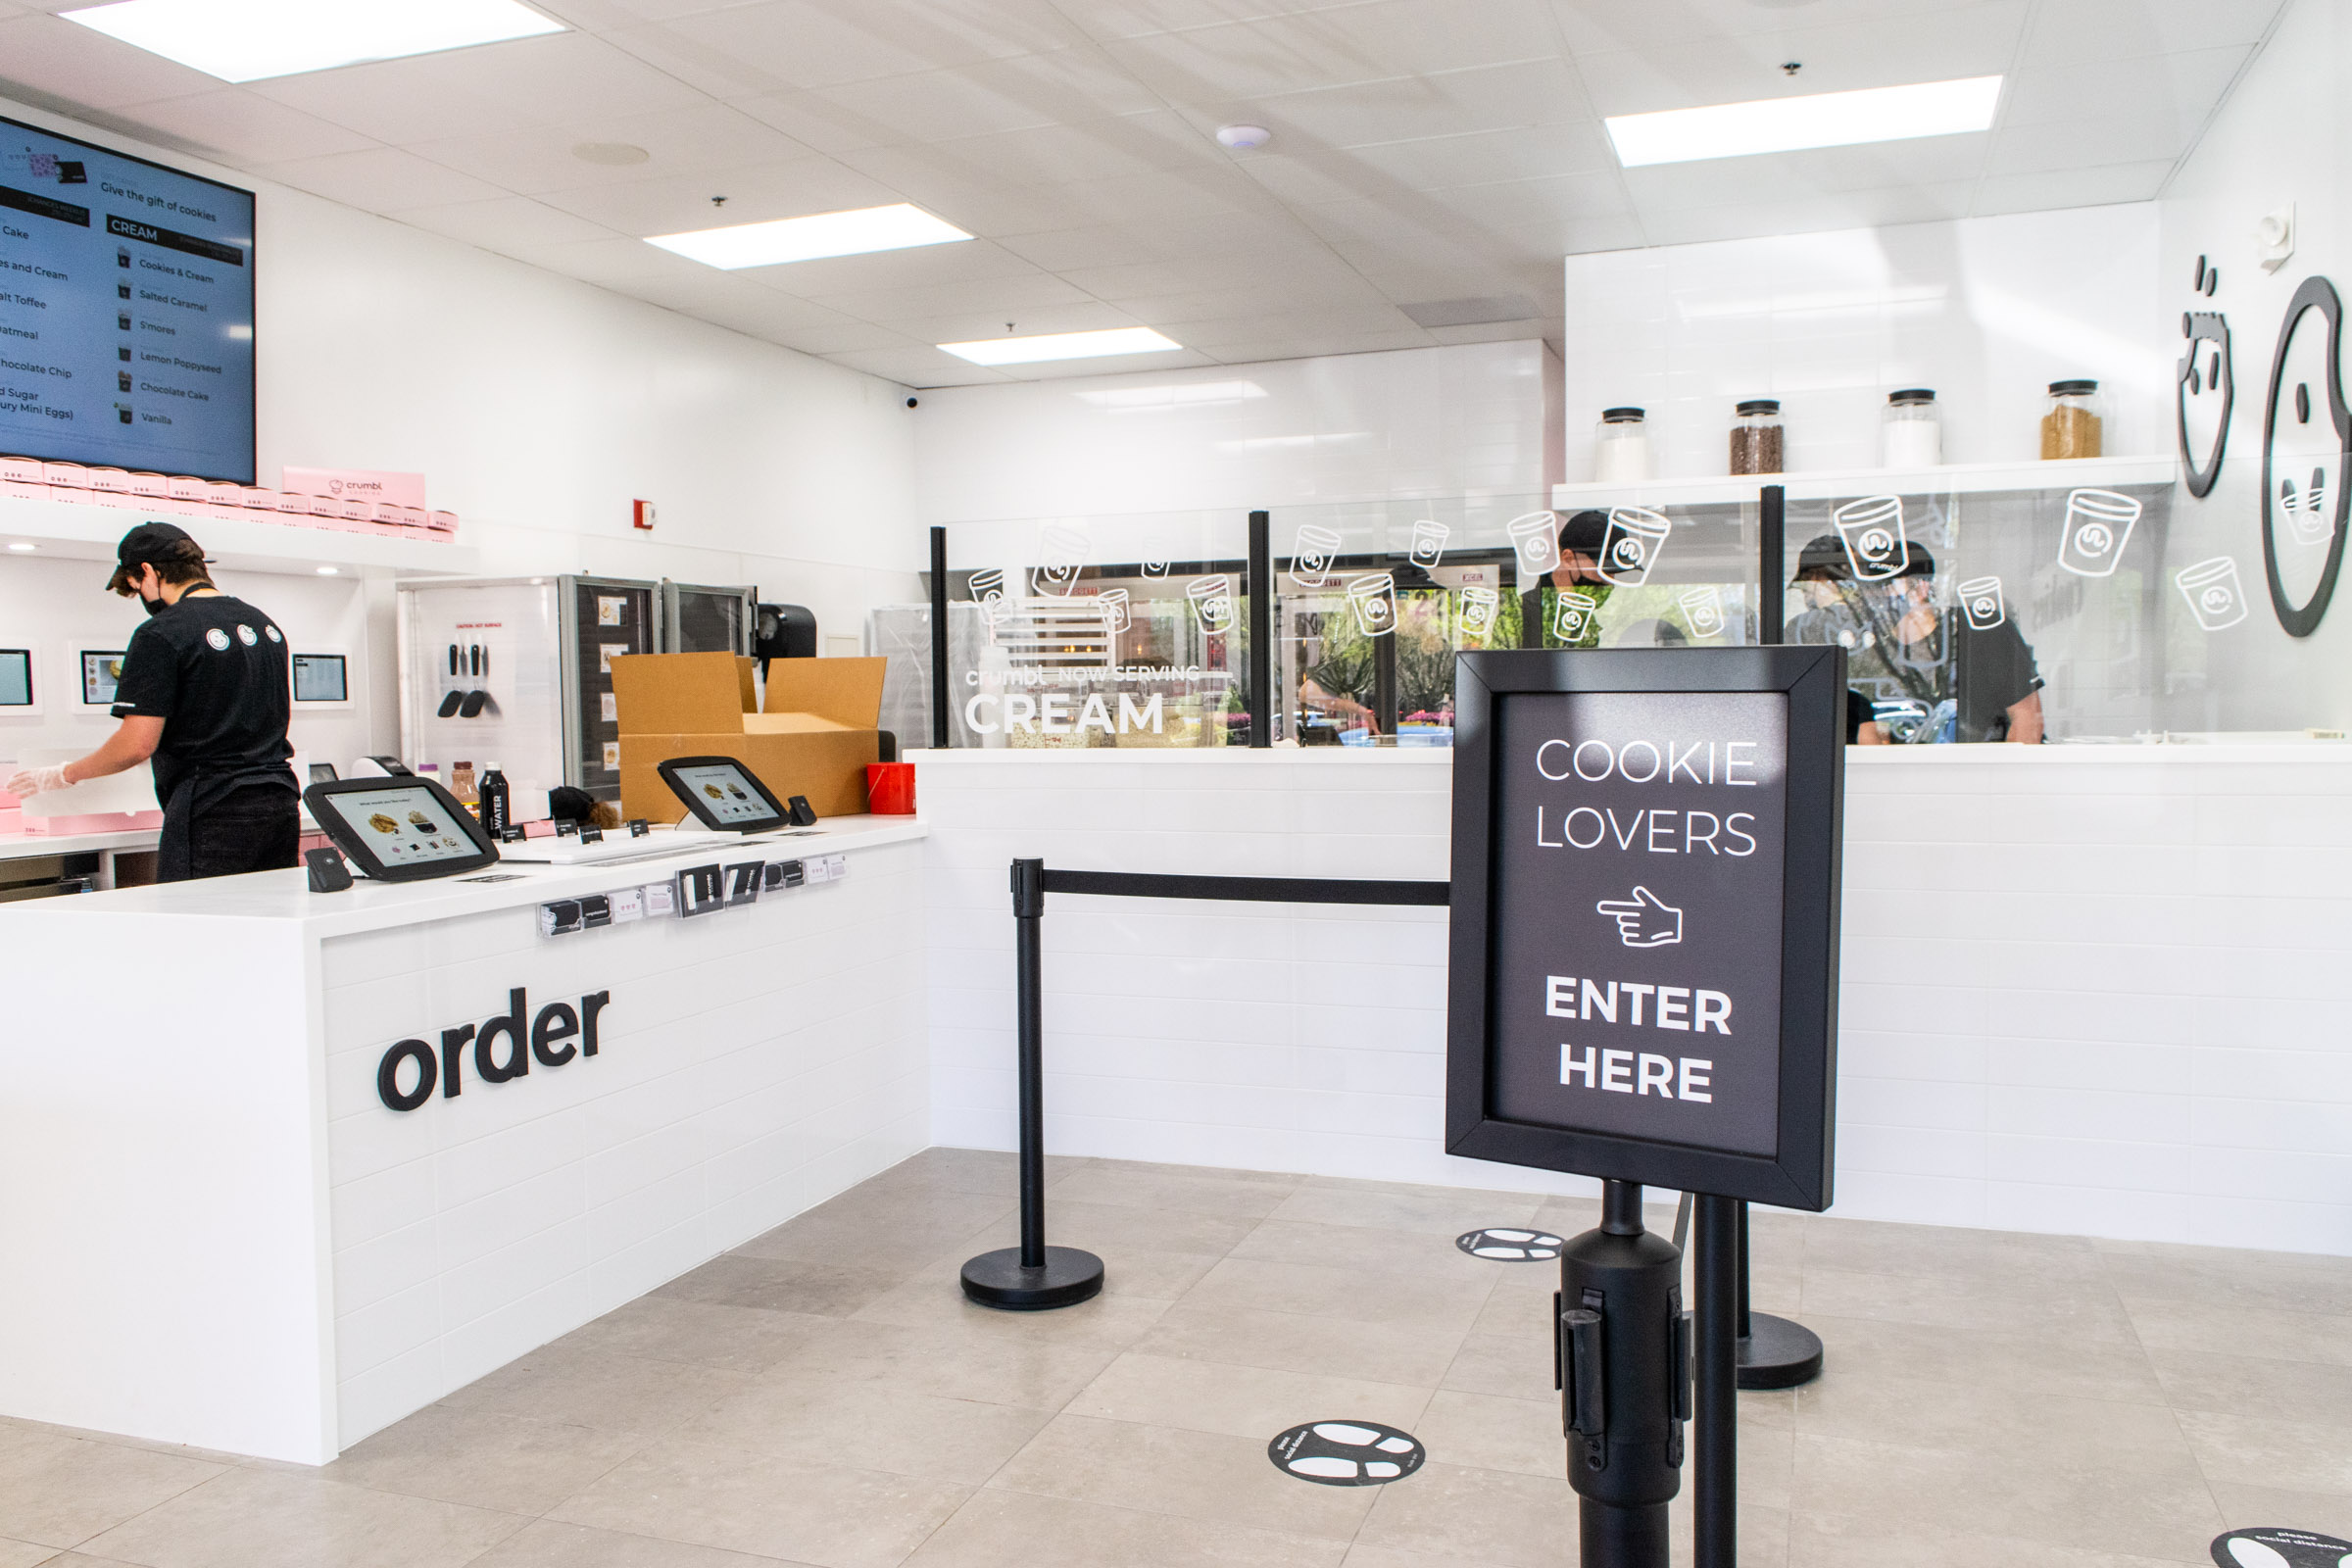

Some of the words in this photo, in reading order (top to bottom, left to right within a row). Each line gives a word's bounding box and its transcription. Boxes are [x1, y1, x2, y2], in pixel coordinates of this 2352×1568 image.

[101, 181, 124, 196] Give
[126, 189, 144, 203] the
[147, 195, 165, 209] gift
[167, 202, 177, 212] of
[179, 205, 217, 222] cookies
[2, 225, 29, 239] Cake
[111, 219, 158, 242] CREAM
[12, 262, 32, 273] and
[34, 267, 69, 281] Cream
[139, 259, 175, 275] Cookies
[176, 268, 183, 277] &
[184, 270, 215, 283] Cream
[15, 294, 47, 310] Toffee
[139, 289, 169, 304] Salted
[171, 297, 209, 313] Caramel
[0, 325, 39, 340] atmeal
[48, 367, 73, 379] Chip
[140, 352, 172, 365] Lemon
[173, 358, 222, 374] Poppyseed
[8, 388, 39, 401] Sugar
[140, 382, 186, 397] Chocolate
[187, 390, 210, 402] Cake
[20, 403, 43, 414] Mini
[45, 406, 74, 420] Eggs)
[141, 413, 172, 425] Vanilla
[346, 480, 383, 491] crumbl
[965, 663, 1047, 686] crumbl
[1057, 666, 1108, 682] NOW
[1113, 664, 1200, 682] SERVING
[964, 692, 1163, 735] CREAM
[1536, 738, 1758, 786] COOKIE
[493, 795, 503, 830] WATER
[1537, 806, 1757, 857] LOVERS
[1545, 975, 1733, 1036] ENTER
[376, 987, 610, 1112] order
[1559, 1043, 1713, 1103] HERE
[1284, 1446, 1297, 1460] social
[1292, 1430, 1308, 1448] distance
[2255, 1535, 2291, 1544] social
[2293, 1540, 2347, 1550] distance
[2278, 1532, 2318, 1541] please
